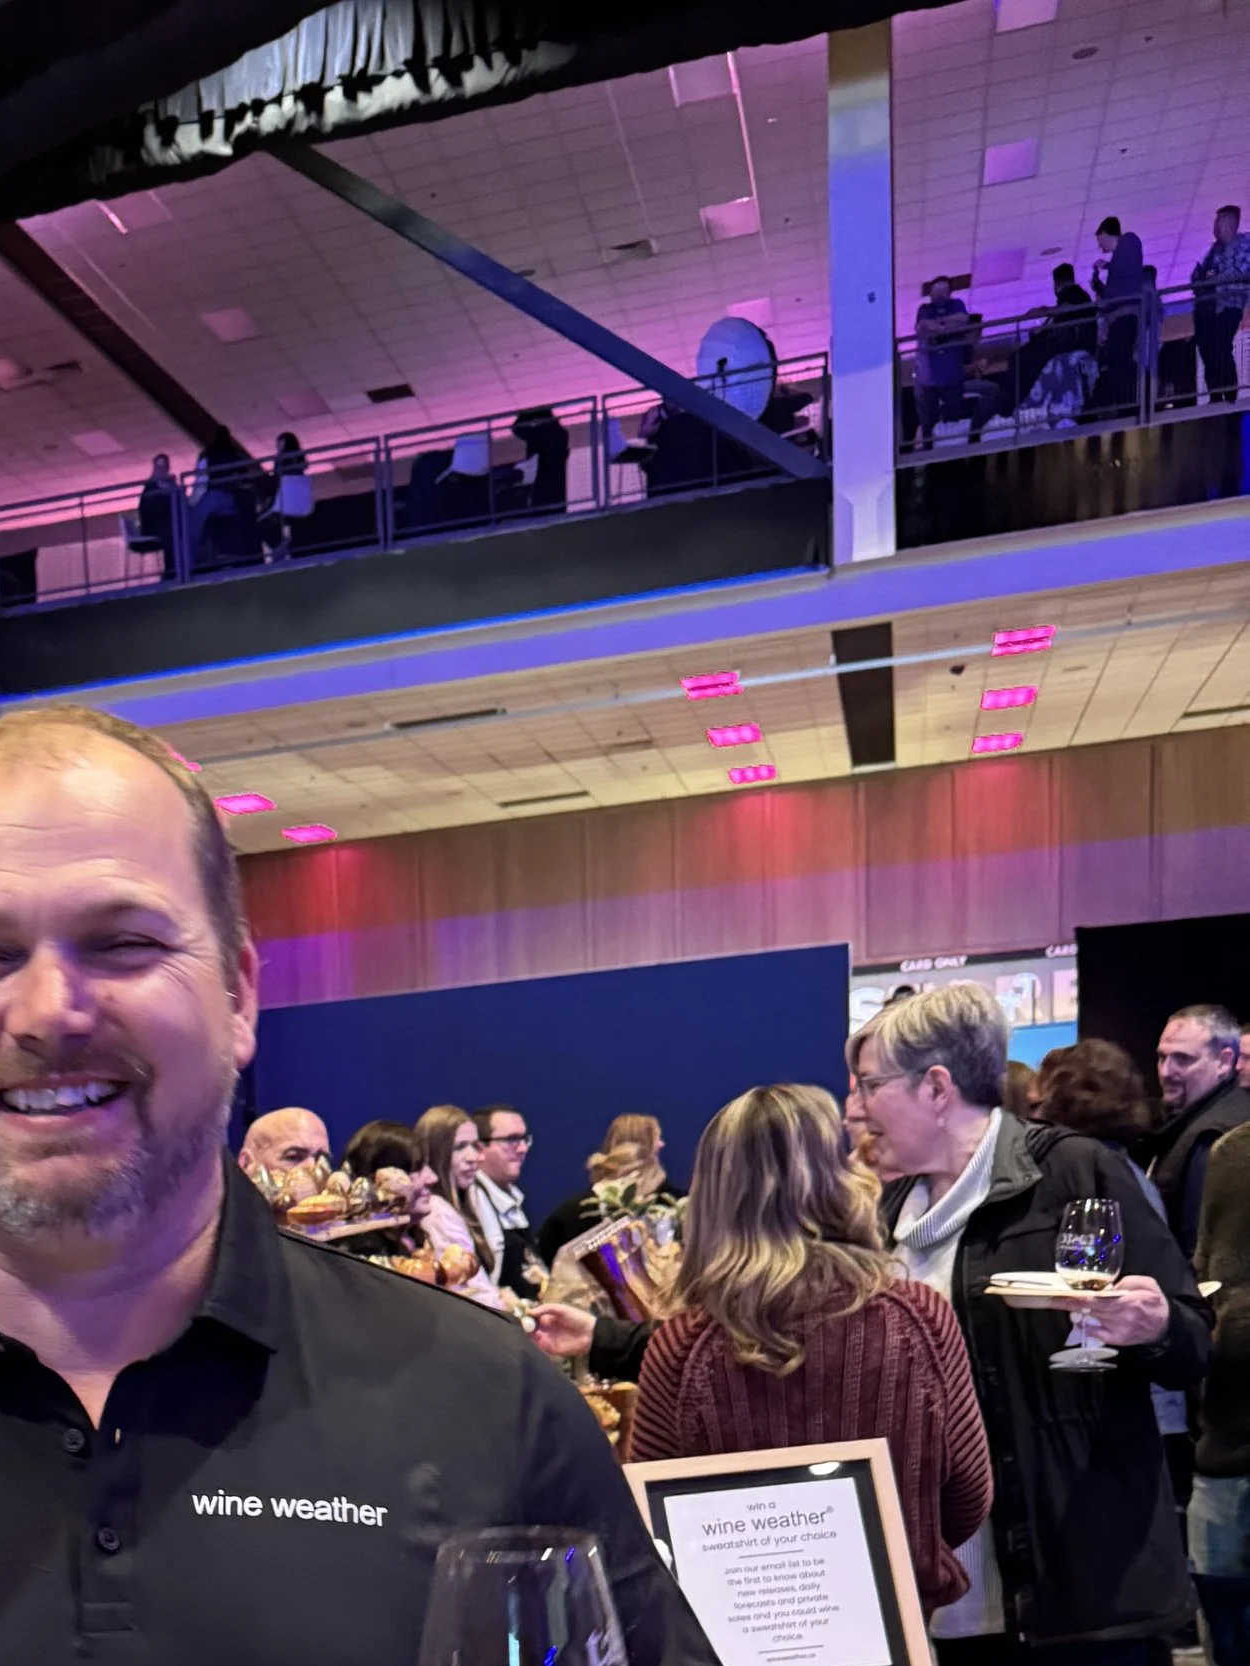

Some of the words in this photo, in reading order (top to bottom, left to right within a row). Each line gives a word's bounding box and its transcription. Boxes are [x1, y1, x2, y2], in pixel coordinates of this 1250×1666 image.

[900, 958, 933, 973] CARD
[934, 955, 968, 970] ONLY
[191, 1489, 263, 1516] wine
[270, 1496, 389, 1527] weather
[747, 1501, 766, 1511] win
[768, 1501, 776, 1510] a
[702, 1518, 746, 1536] wine
[702, 1537, 759, 1552] sweatshirt
[760, 1536, 772, 1546] of
[774, 1534, 798, 1547] your
[800, 1530, 837, 1541] choice
